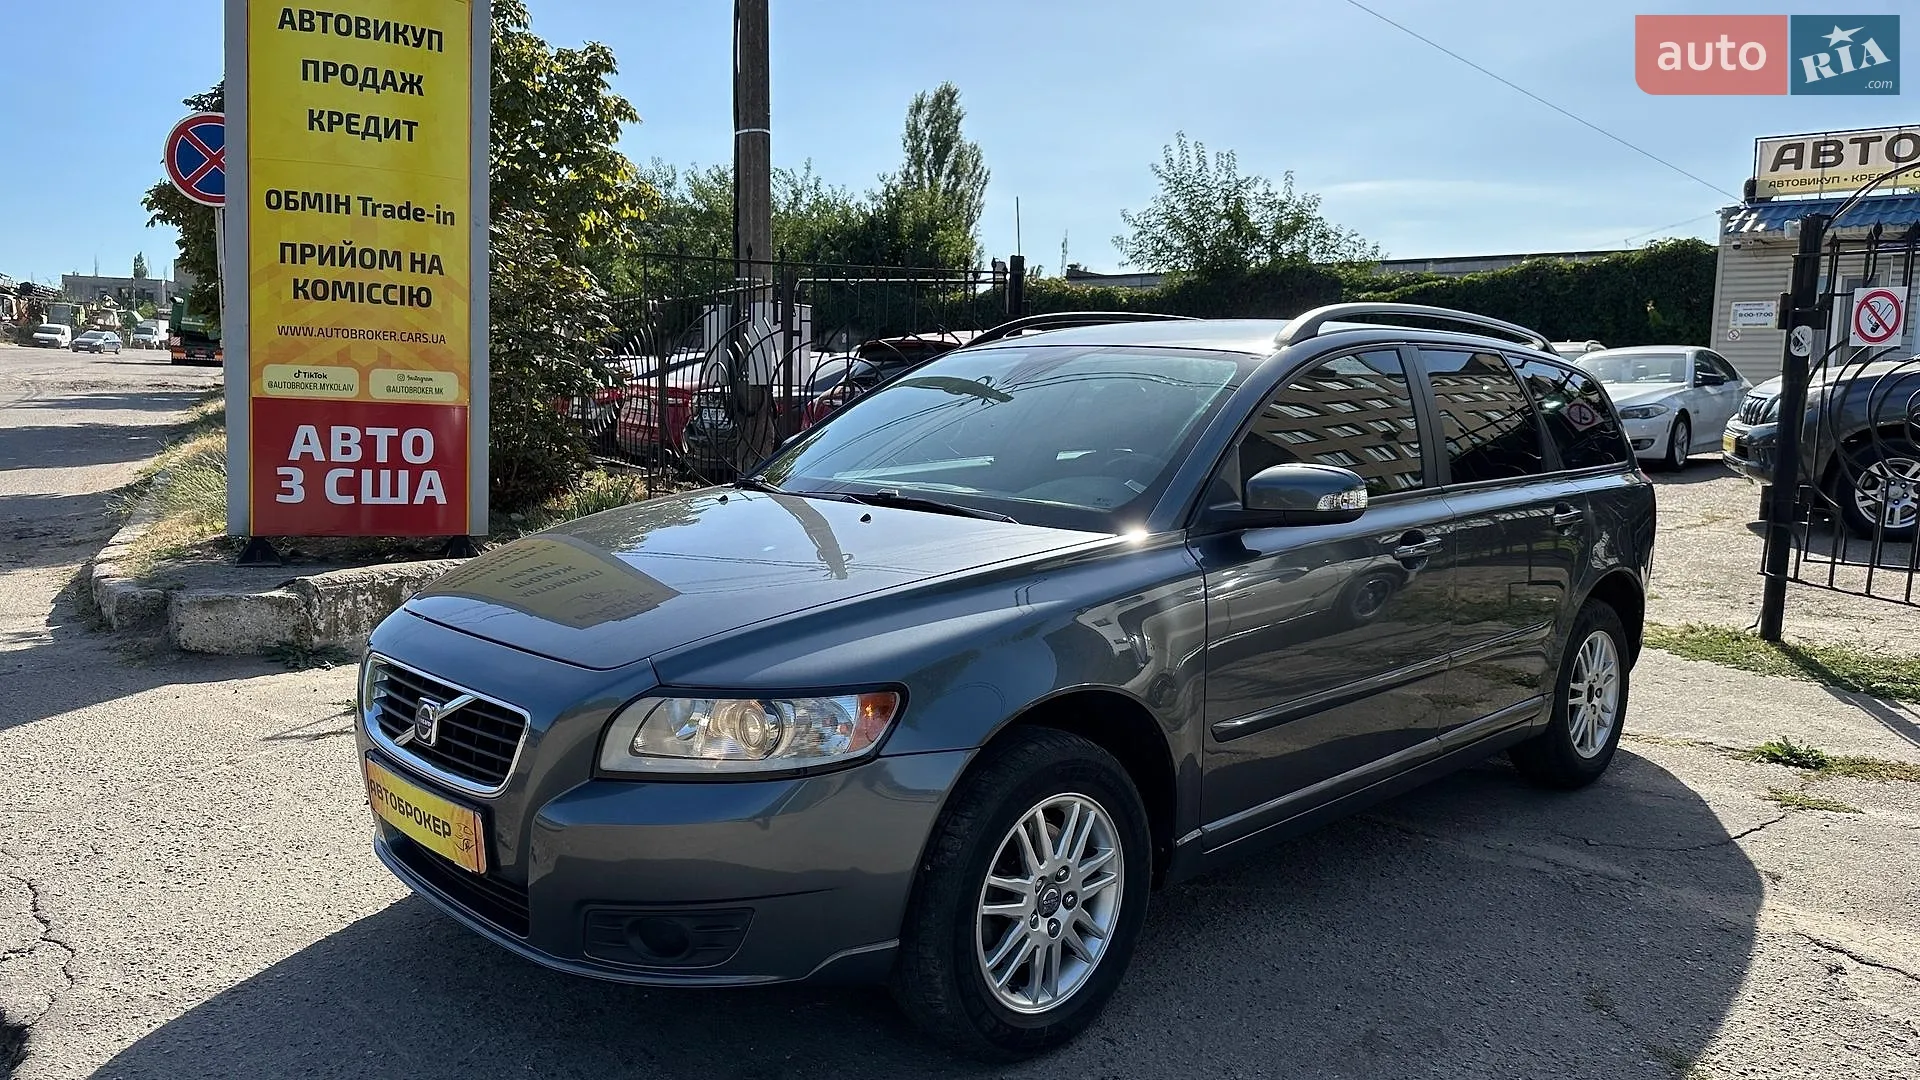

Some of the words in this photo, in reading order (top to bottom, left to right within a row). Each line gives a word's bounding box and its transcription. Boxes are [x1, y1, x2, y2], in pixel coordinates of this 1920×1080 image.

[278, 8, 443, 52] АВТОВИКУП
[301, 59, 424, 96] ПРОДАЖ
[307, 109, 418, 142] КРЕДИТ
[1767, 175, 1840, 189] АВТОВИКУП
[265, 189, 351, 215] ОБМІН
[357, 196, 455, 226] Trade-in
[279, 240, 402, 272] ПРИЙОМ
[410, 252, 444, 275] НА
[292, 278, 432, 308] КОМІССІЮ
[277, 325, 447, 345] WWW.AUTOBROKER.CARS.UA
[267, 380, 354, 392] @AUTOBROKER.MYKOLAIV
[303, 370, 328, 380] TikTok
[386, 385, 444, 395] @AUTOBROKER.MK
[407, 374, 433, 384] Instagram
[287, 424, 434, 464] АВТО
[275, 466, 305, 503] З
[324, 467, 448, 505] США
[369, 778, 452, 838] АВТОБРОКЕР
